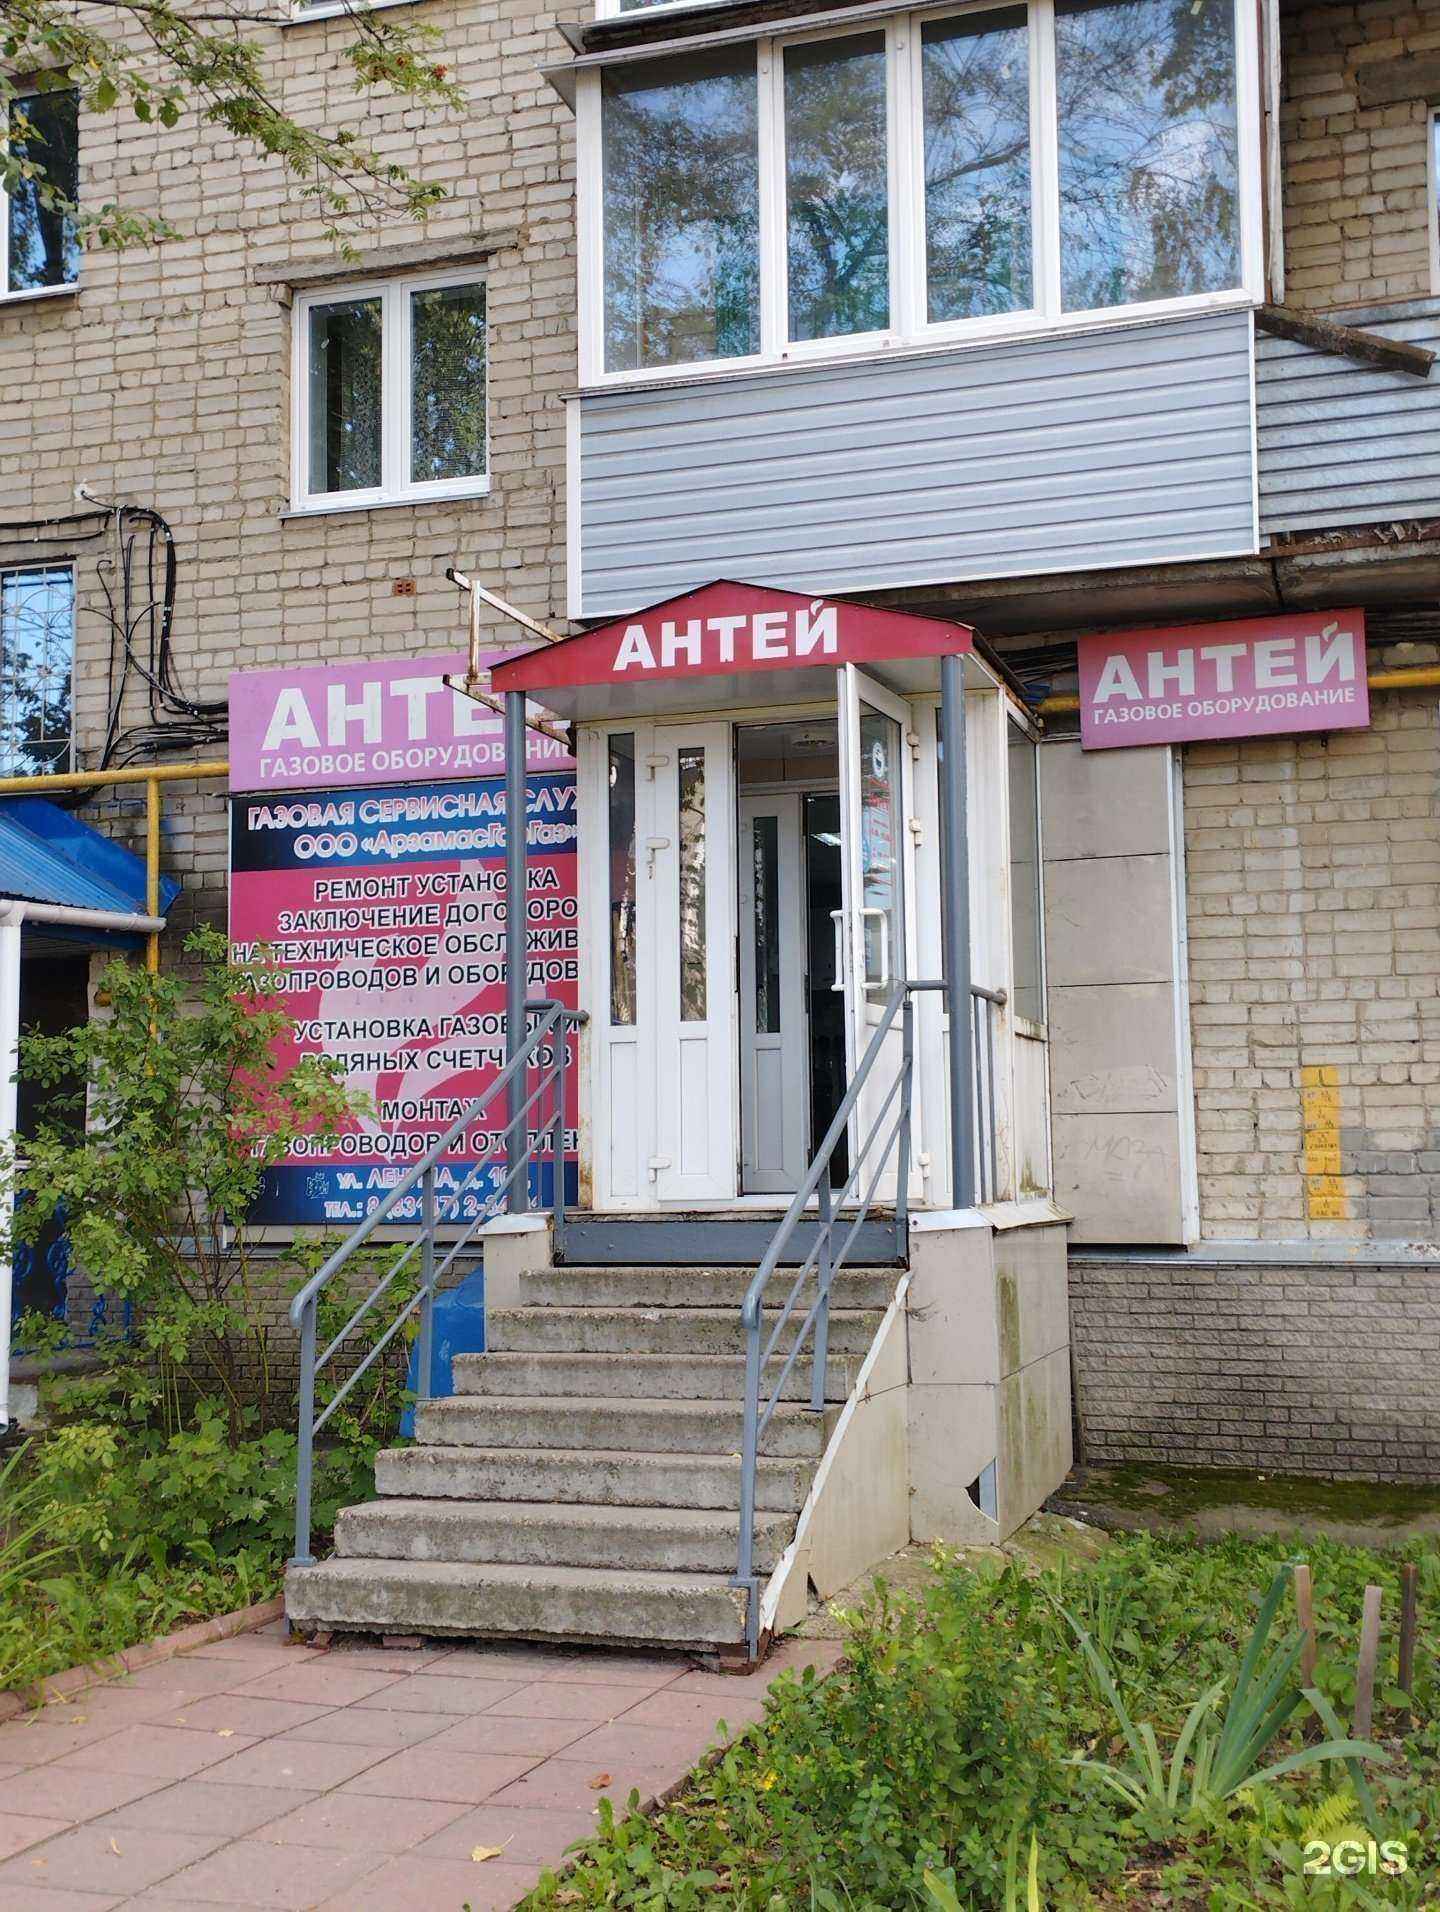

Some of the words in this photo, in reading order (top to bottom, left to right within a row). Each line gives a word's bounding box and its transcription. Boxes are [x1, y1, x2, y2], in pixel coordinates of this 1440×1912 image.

[612, 600, 838, 671] АНТЕЙ
[1092, 621, 1356, 704] АНТЕЙ
[1094, 703, 1183, 724] ГАЗОВОЕ
[1187, 687, 1356, 715] ОБОРУДОВАНИЕ
[260, 752, 366, 778] ГАЗОВОЕ
[247, 801, 356, 831] ГАЗОВАЯ
[359, 790, 507, 825] СЕРВИСНАЯ
[294, 832, 358, 860] ООО
[314, 875, 411, 902] РЕМОНТ
[416, 866, 560, 897] УСТАНОКА
[278, 904, 440, 933] ЗАКЛЮЧЕНИЕ
[270, 934, 439, 963] ТЕХНИЧЕСКОЕ
[425, 965, 441, 987] И
[294, 1017, 433, 1042] УСТАНОВКА
